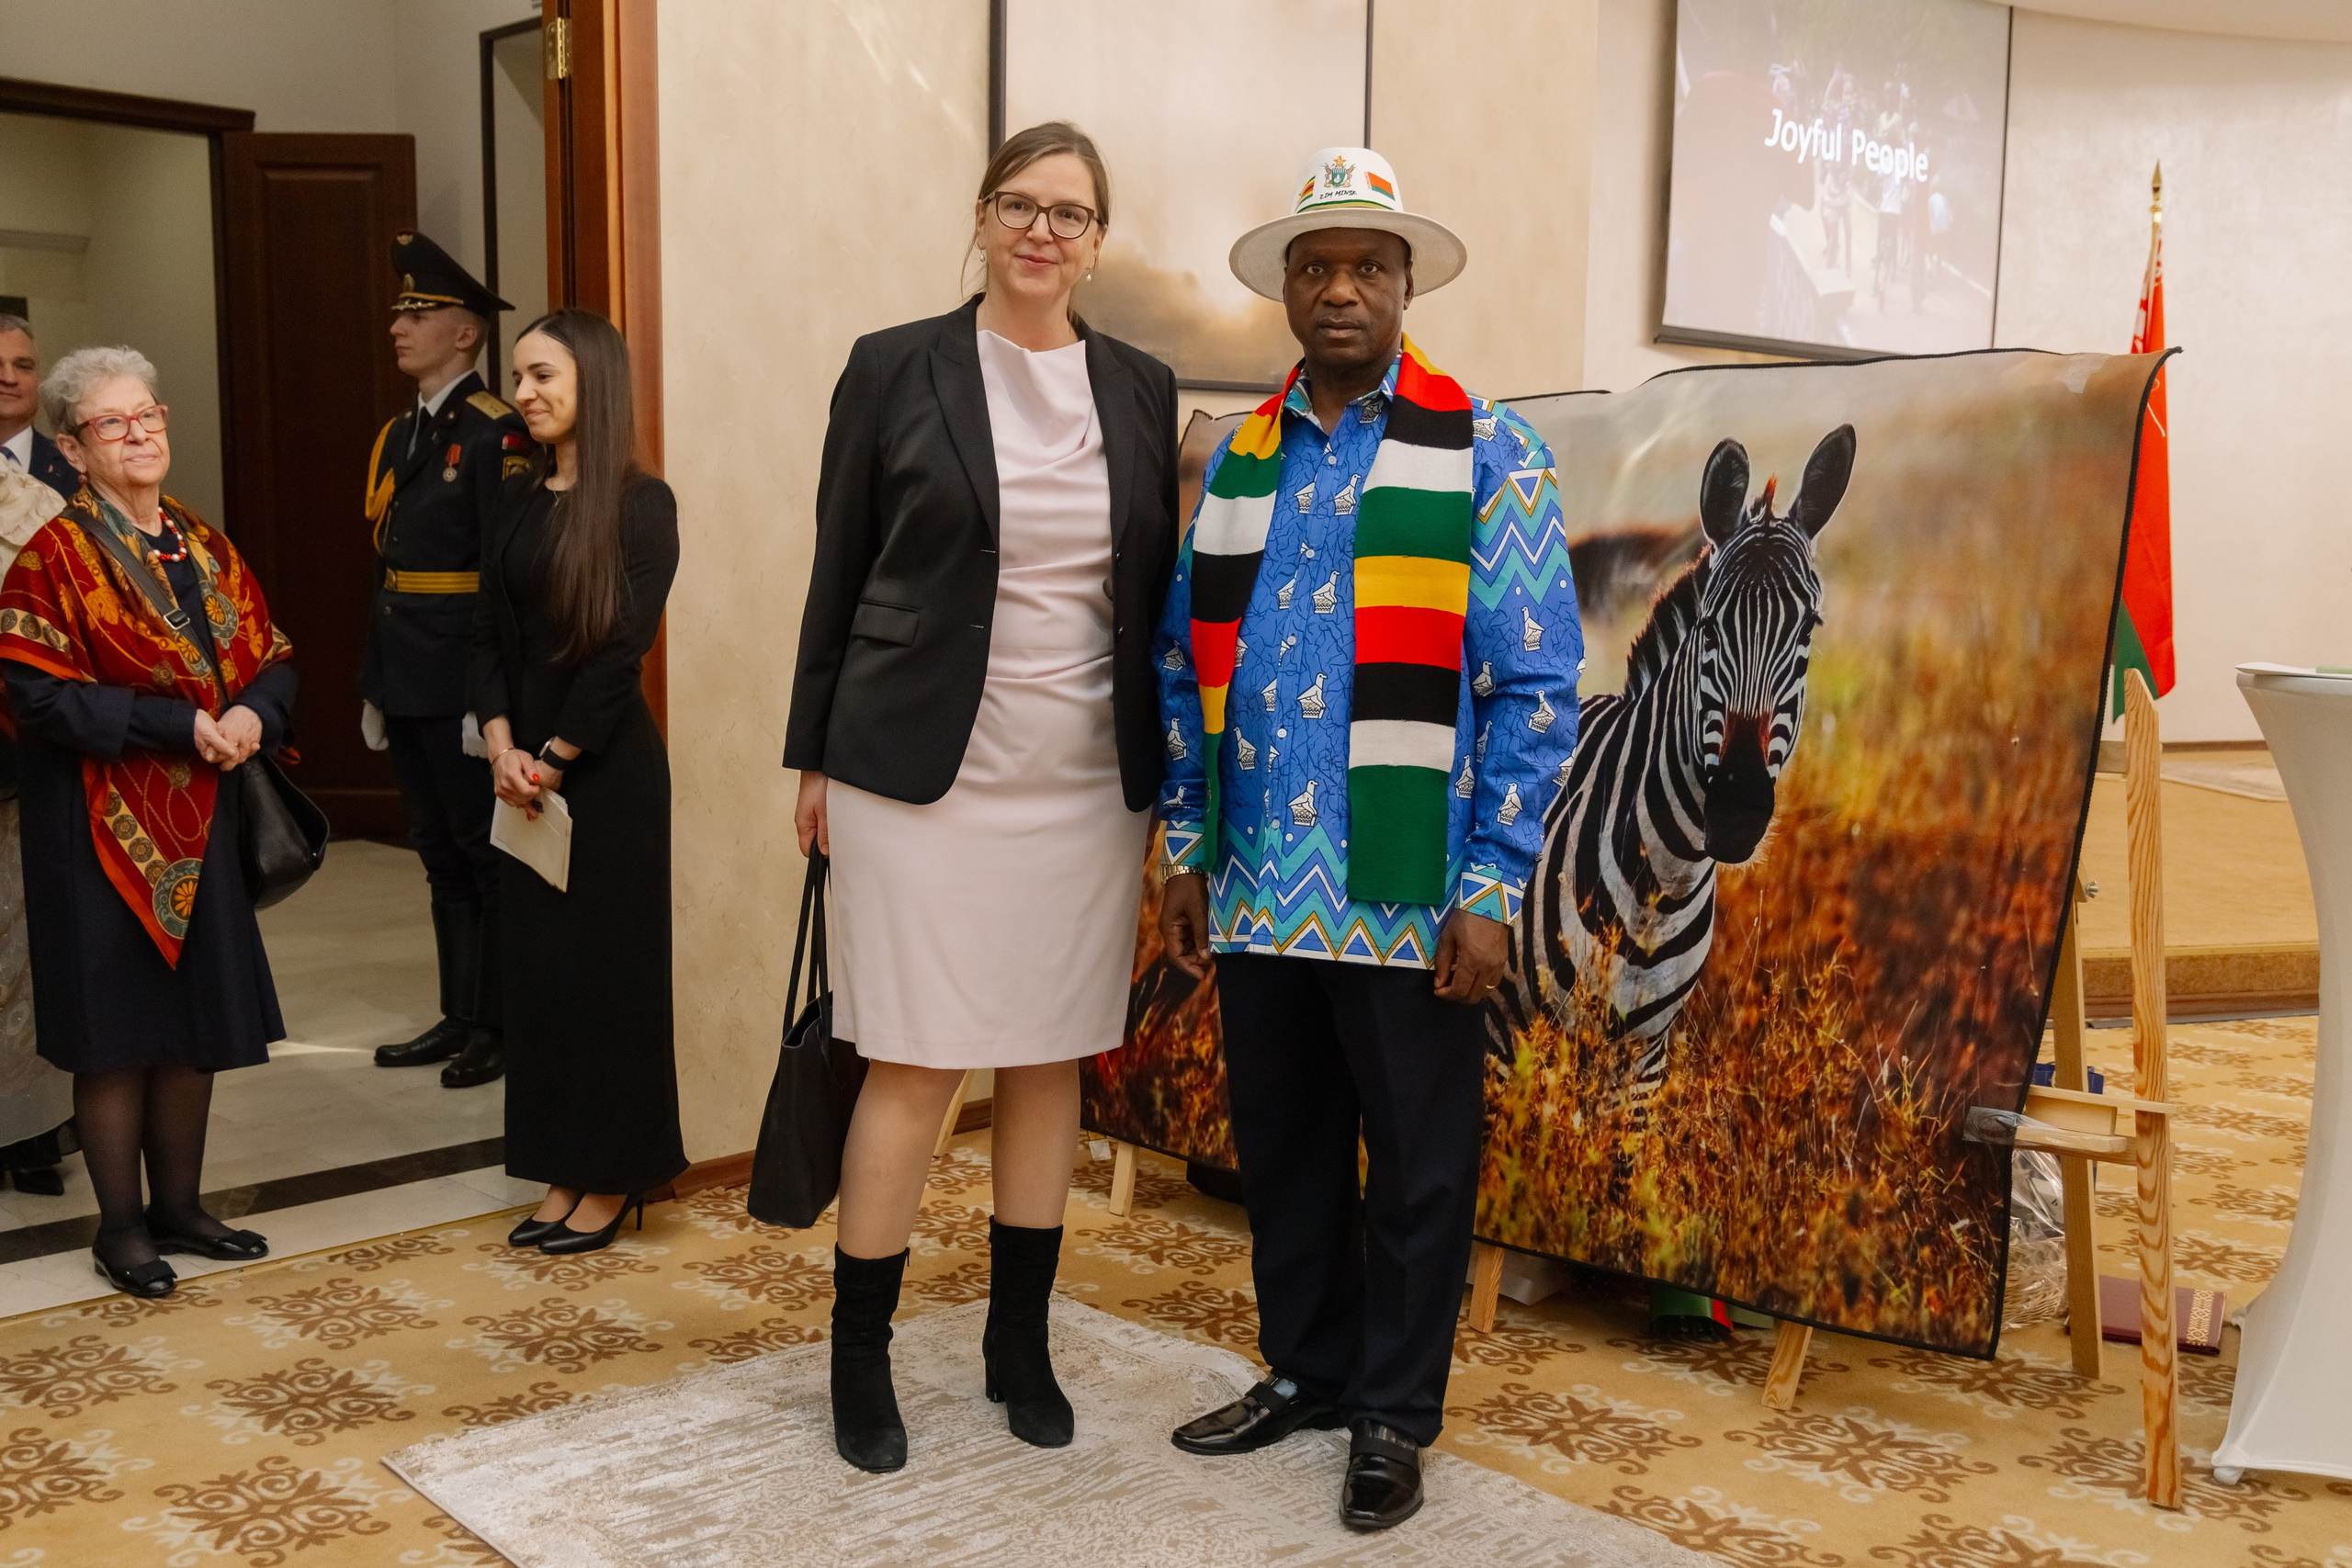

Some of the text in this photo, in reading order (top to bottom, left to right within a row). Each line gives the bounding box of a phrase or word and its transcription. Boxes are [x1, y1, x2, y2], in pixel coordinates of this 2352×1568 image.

[1764, 108, 1928, 186] Joyful People
[1319, 192, 1333, 200] ZIM
